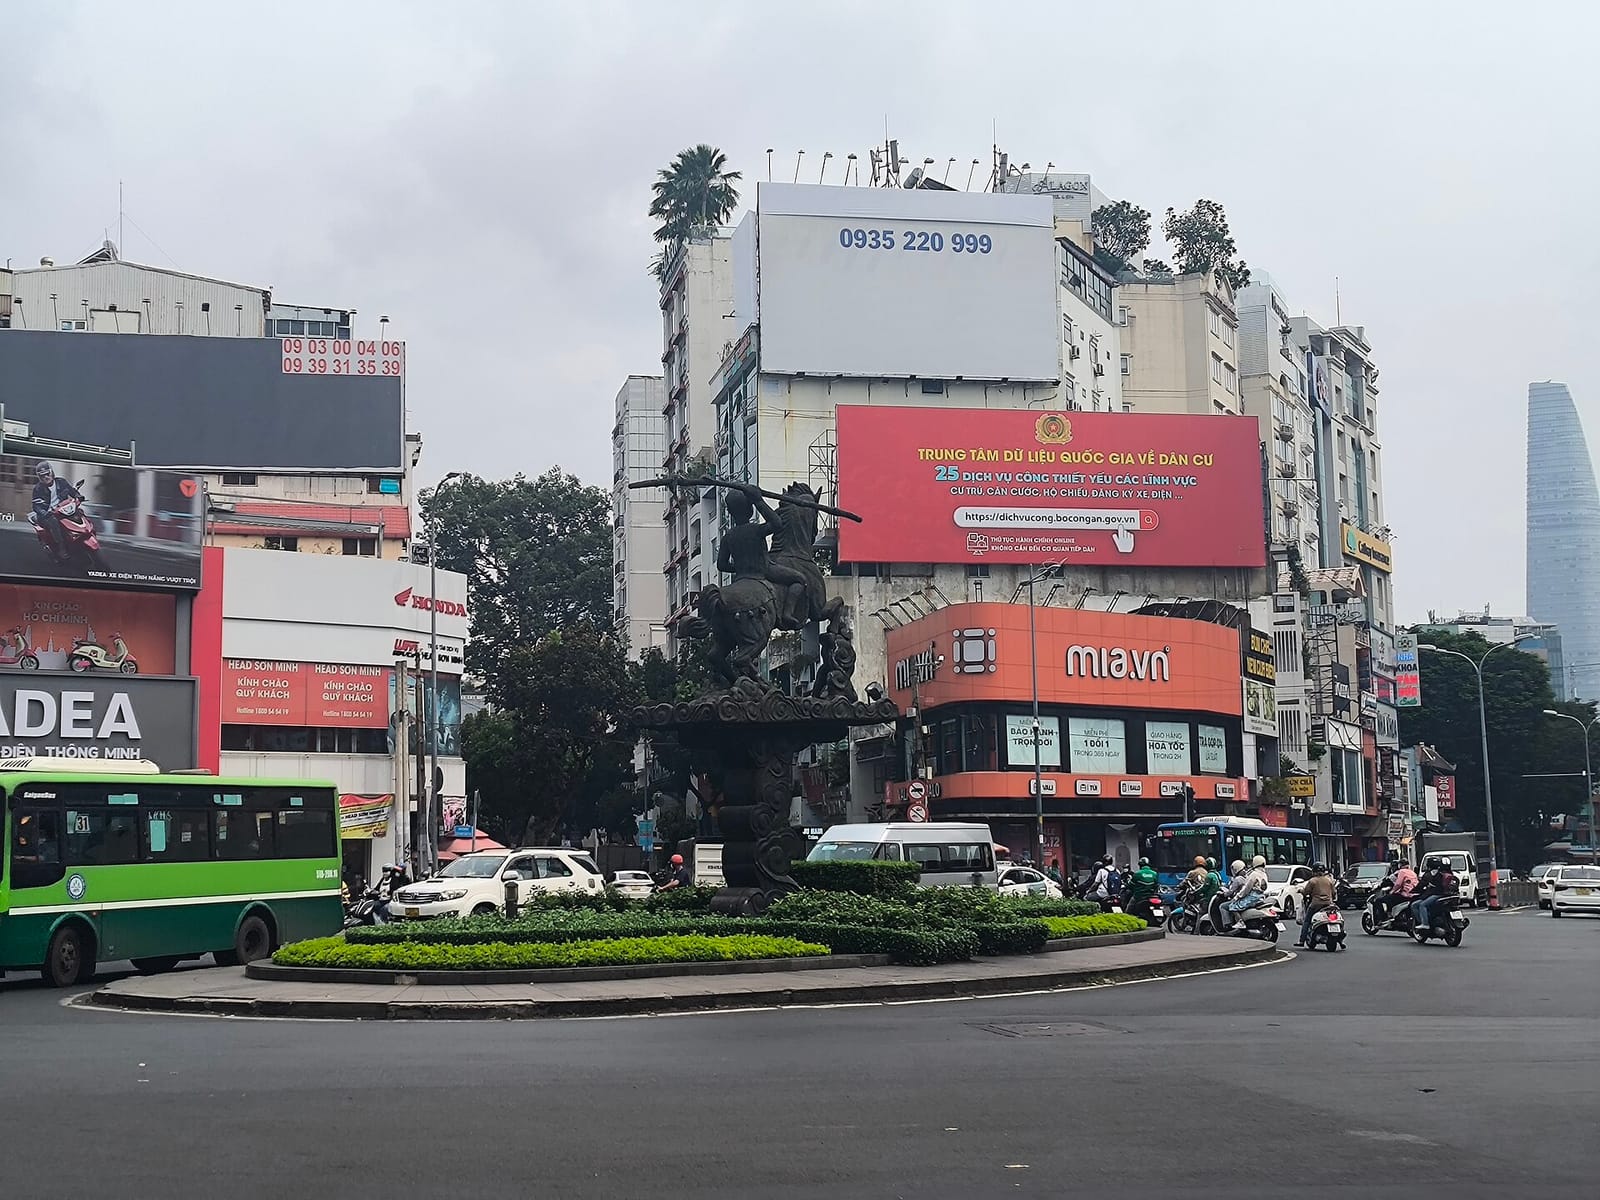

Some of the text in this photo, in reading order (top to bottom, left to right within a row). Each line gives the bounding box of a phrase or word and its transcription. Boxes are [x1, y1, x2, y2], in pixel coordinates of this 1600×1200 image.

[840, 228, 992, 254] 0935 220 999
[283, 339, 400, 356] 09 03 00 04 06
[283, 358, 400, 374] 09 39 31 35 39
[918, 448, 1214, 466] TRUNG TÂM DỮ LIỆU QUỐC GIA VỀ DÂN CƯ
[934, 465, 1197, 488] 25 DỊCH VỤ CÔNG THIẾT YẾU CÁC LĨNH VỰC
[965, 512, 1136, 525] https://dichvucong.bocongan.gov.vn
[412, 595, 468, 617] HONDA
[1397, 652, 1414, 660] NHA
[228, 660, 252, 670] HEAD
[276, 662, 298, 672] MINH
[315, 664, 338, 674] HEAD
[360, 666, 380, 676] MINH
[1396, 664, 1417, 672] KHOA
[238, 676, 288, 688] KÍNH CHÀO
[324, 680, 372, 692] KÍNH CHÀO
[236, 688, 290, 698] QUÝ KHÁCH
[322, 692, 373, 702] QUÝ KHÁCH
[0, 689, 142, 739] DEA
[1105, 740, 1109, 748] 1
[45, 743, 98, 758] THÔNG
[104, 747, 140, 760] MINH
[1154, 752, 1173, 760] TRONG
[77, 817, 88, 831] 31
